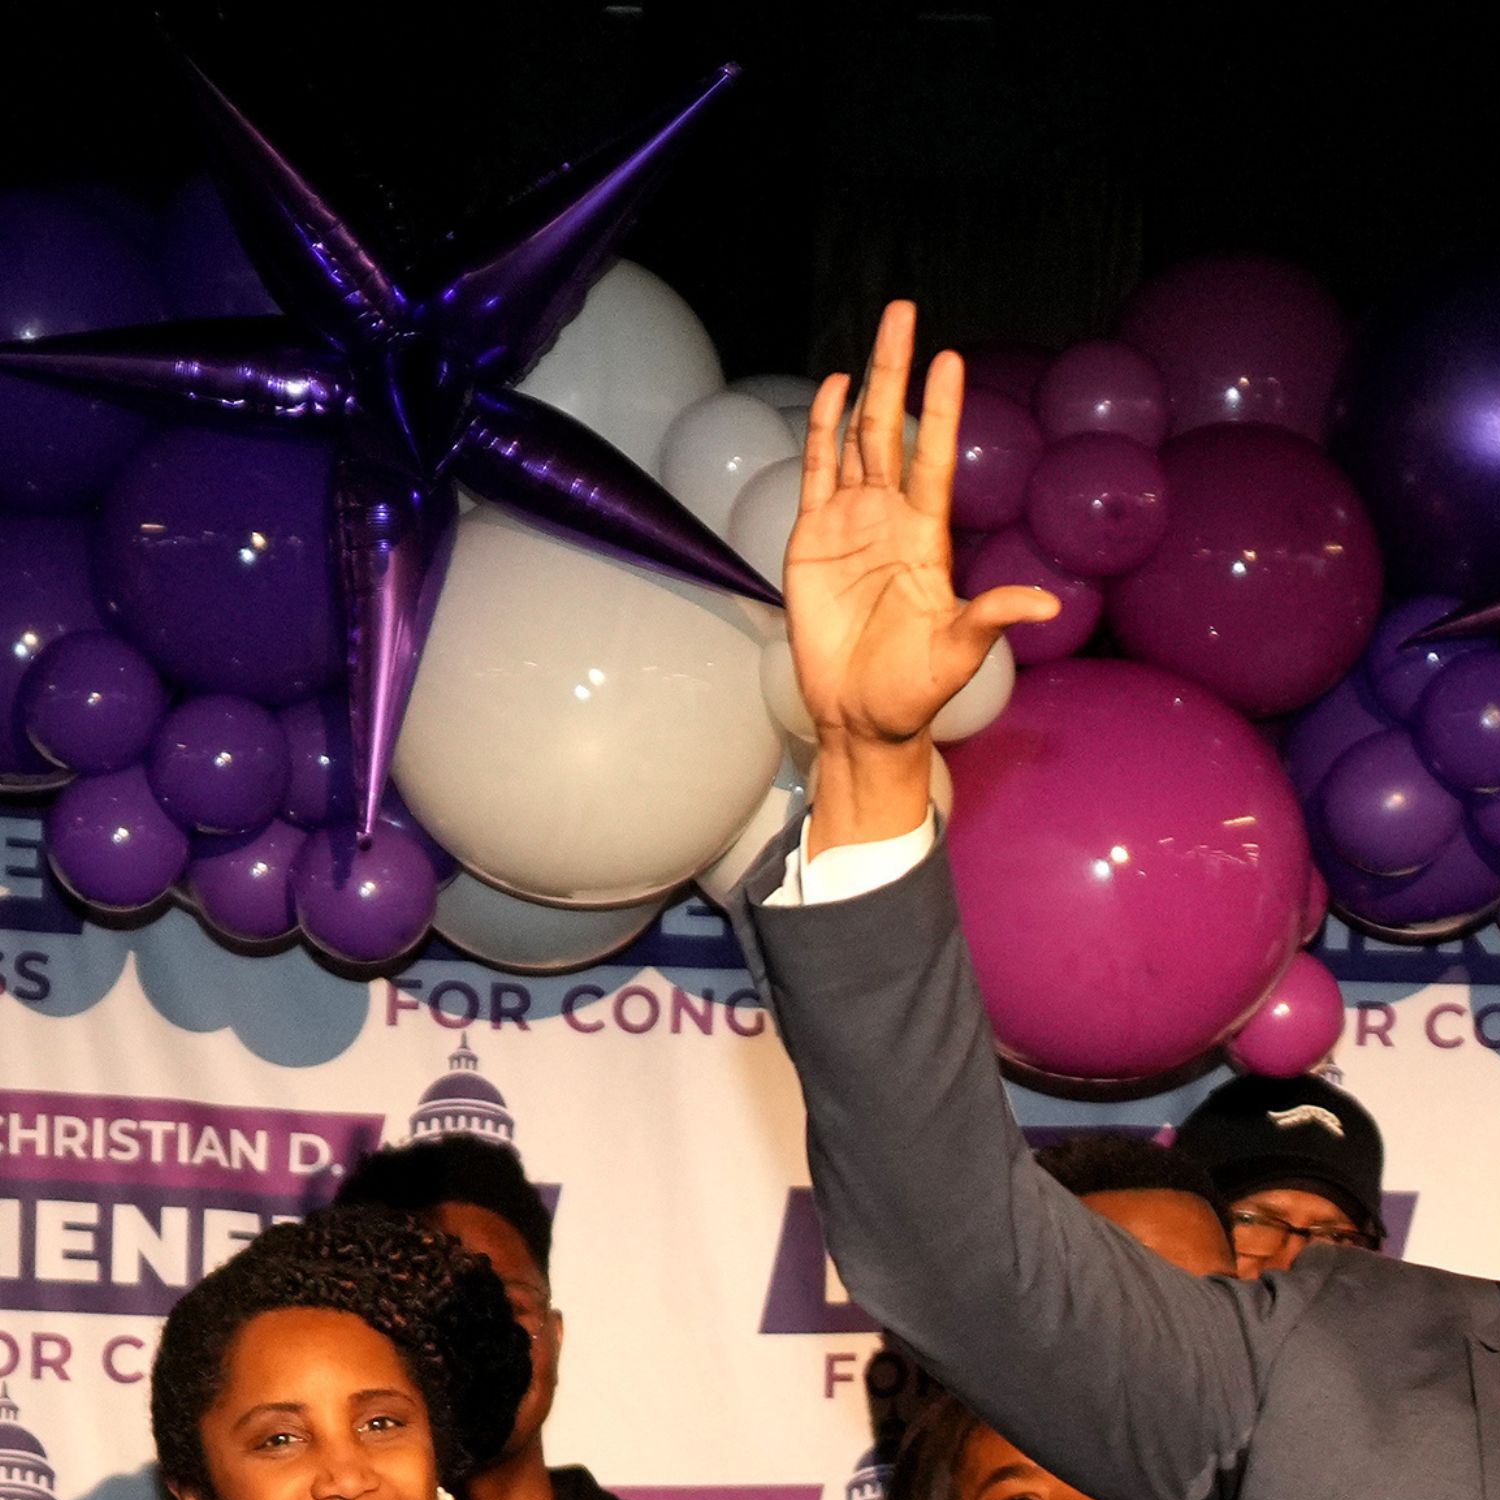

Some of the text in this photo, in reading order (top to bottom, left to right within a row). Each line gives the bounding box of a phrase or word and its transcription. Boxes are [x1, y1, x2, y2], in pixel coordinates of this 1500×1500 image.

[385, 978, 767, 1037] FOR CONG
[0, 1110, 345, 1177] HRISTIAN D.
